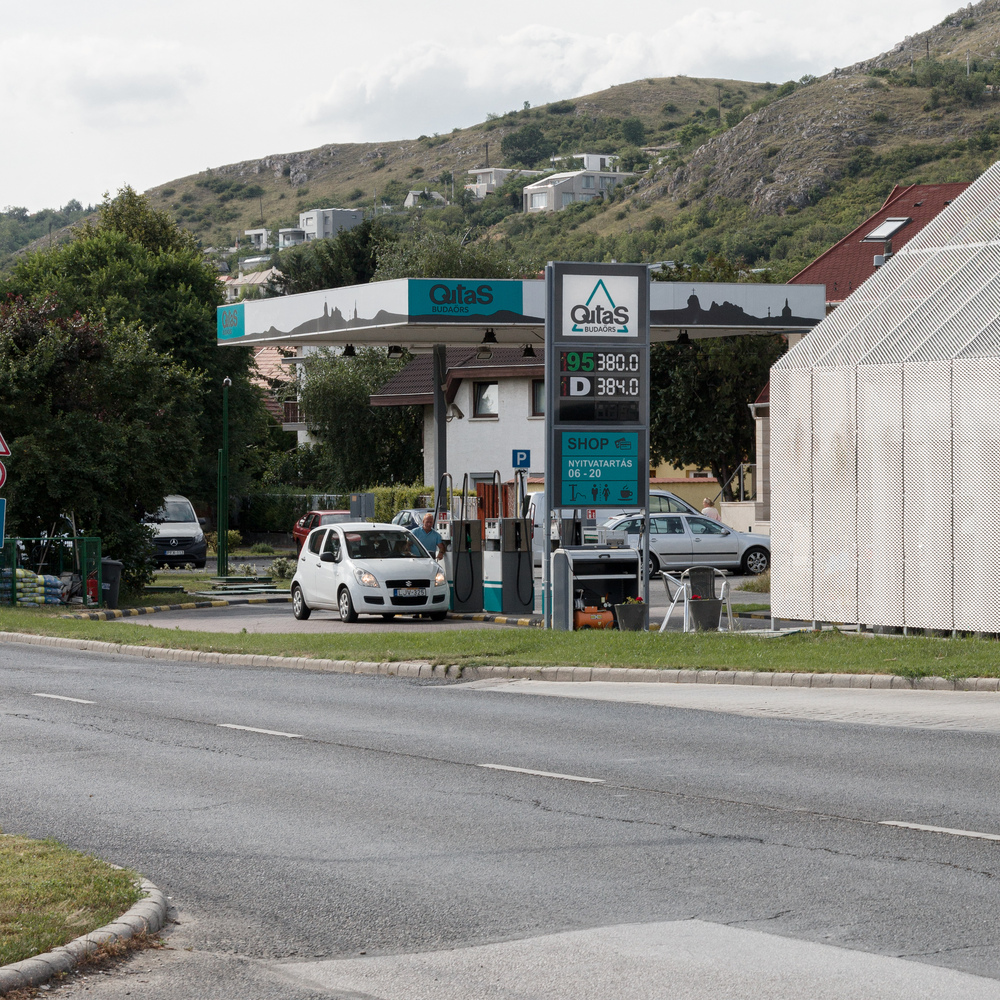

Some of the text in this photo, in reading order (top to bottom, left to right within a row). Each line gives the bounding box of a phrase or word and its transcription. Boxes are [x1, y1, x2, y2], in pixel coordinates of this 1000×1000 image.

[432, 305, 469, 313] BUDAÖRS
[584, 325, 616, 333] BUDAÖRS
[566, 352, 595, 371] 95
[597, 353, 639, 371] 380.0
[570, 377, 591, 396] D
[597, 378, 639, 396] 384.0
[568, 437, 609, 450] SHOP
[517, 452, 527, 466] P
[568, 458, 633, 468] NYITVATARTÁS
[568, 469, 581, 478] 06
[589, 469, 602, 478] 20
